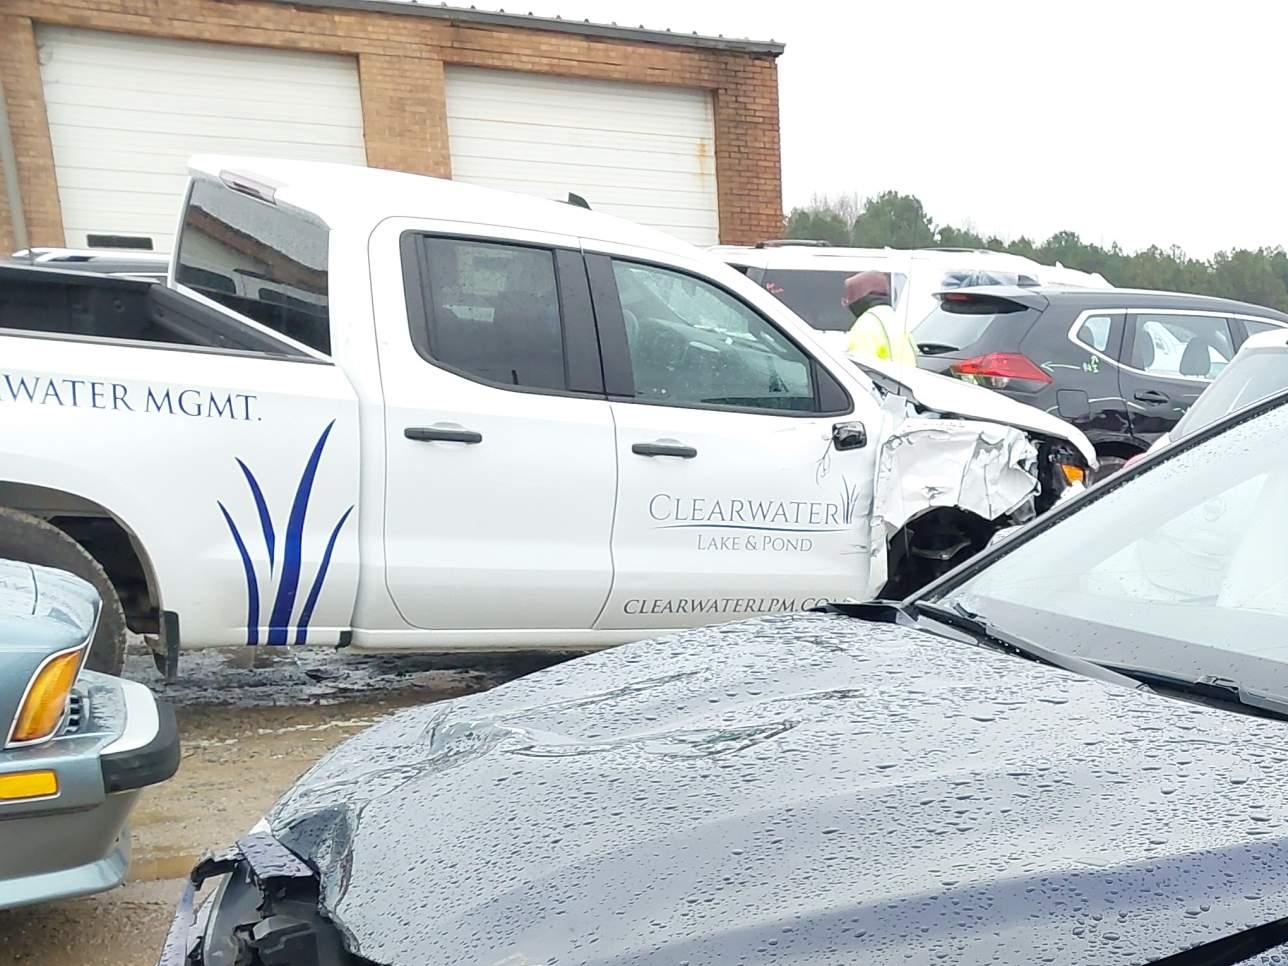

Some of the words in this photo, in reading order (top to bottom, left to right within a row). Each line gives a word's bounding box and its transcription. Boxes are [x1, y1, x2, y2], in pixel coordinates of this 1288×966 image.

[0, 373, 134, 412] WATER
[145, 385, 263, 421] MGMT.
[648, 492, 840, 525] CLEARWATER
[696, 533, 741, 551] LAKE
[744, 535, 758, 551] &
[762, 535, 813, 552] POND
[622, 597, 849, 615] CLEARWATERLPM.CO
